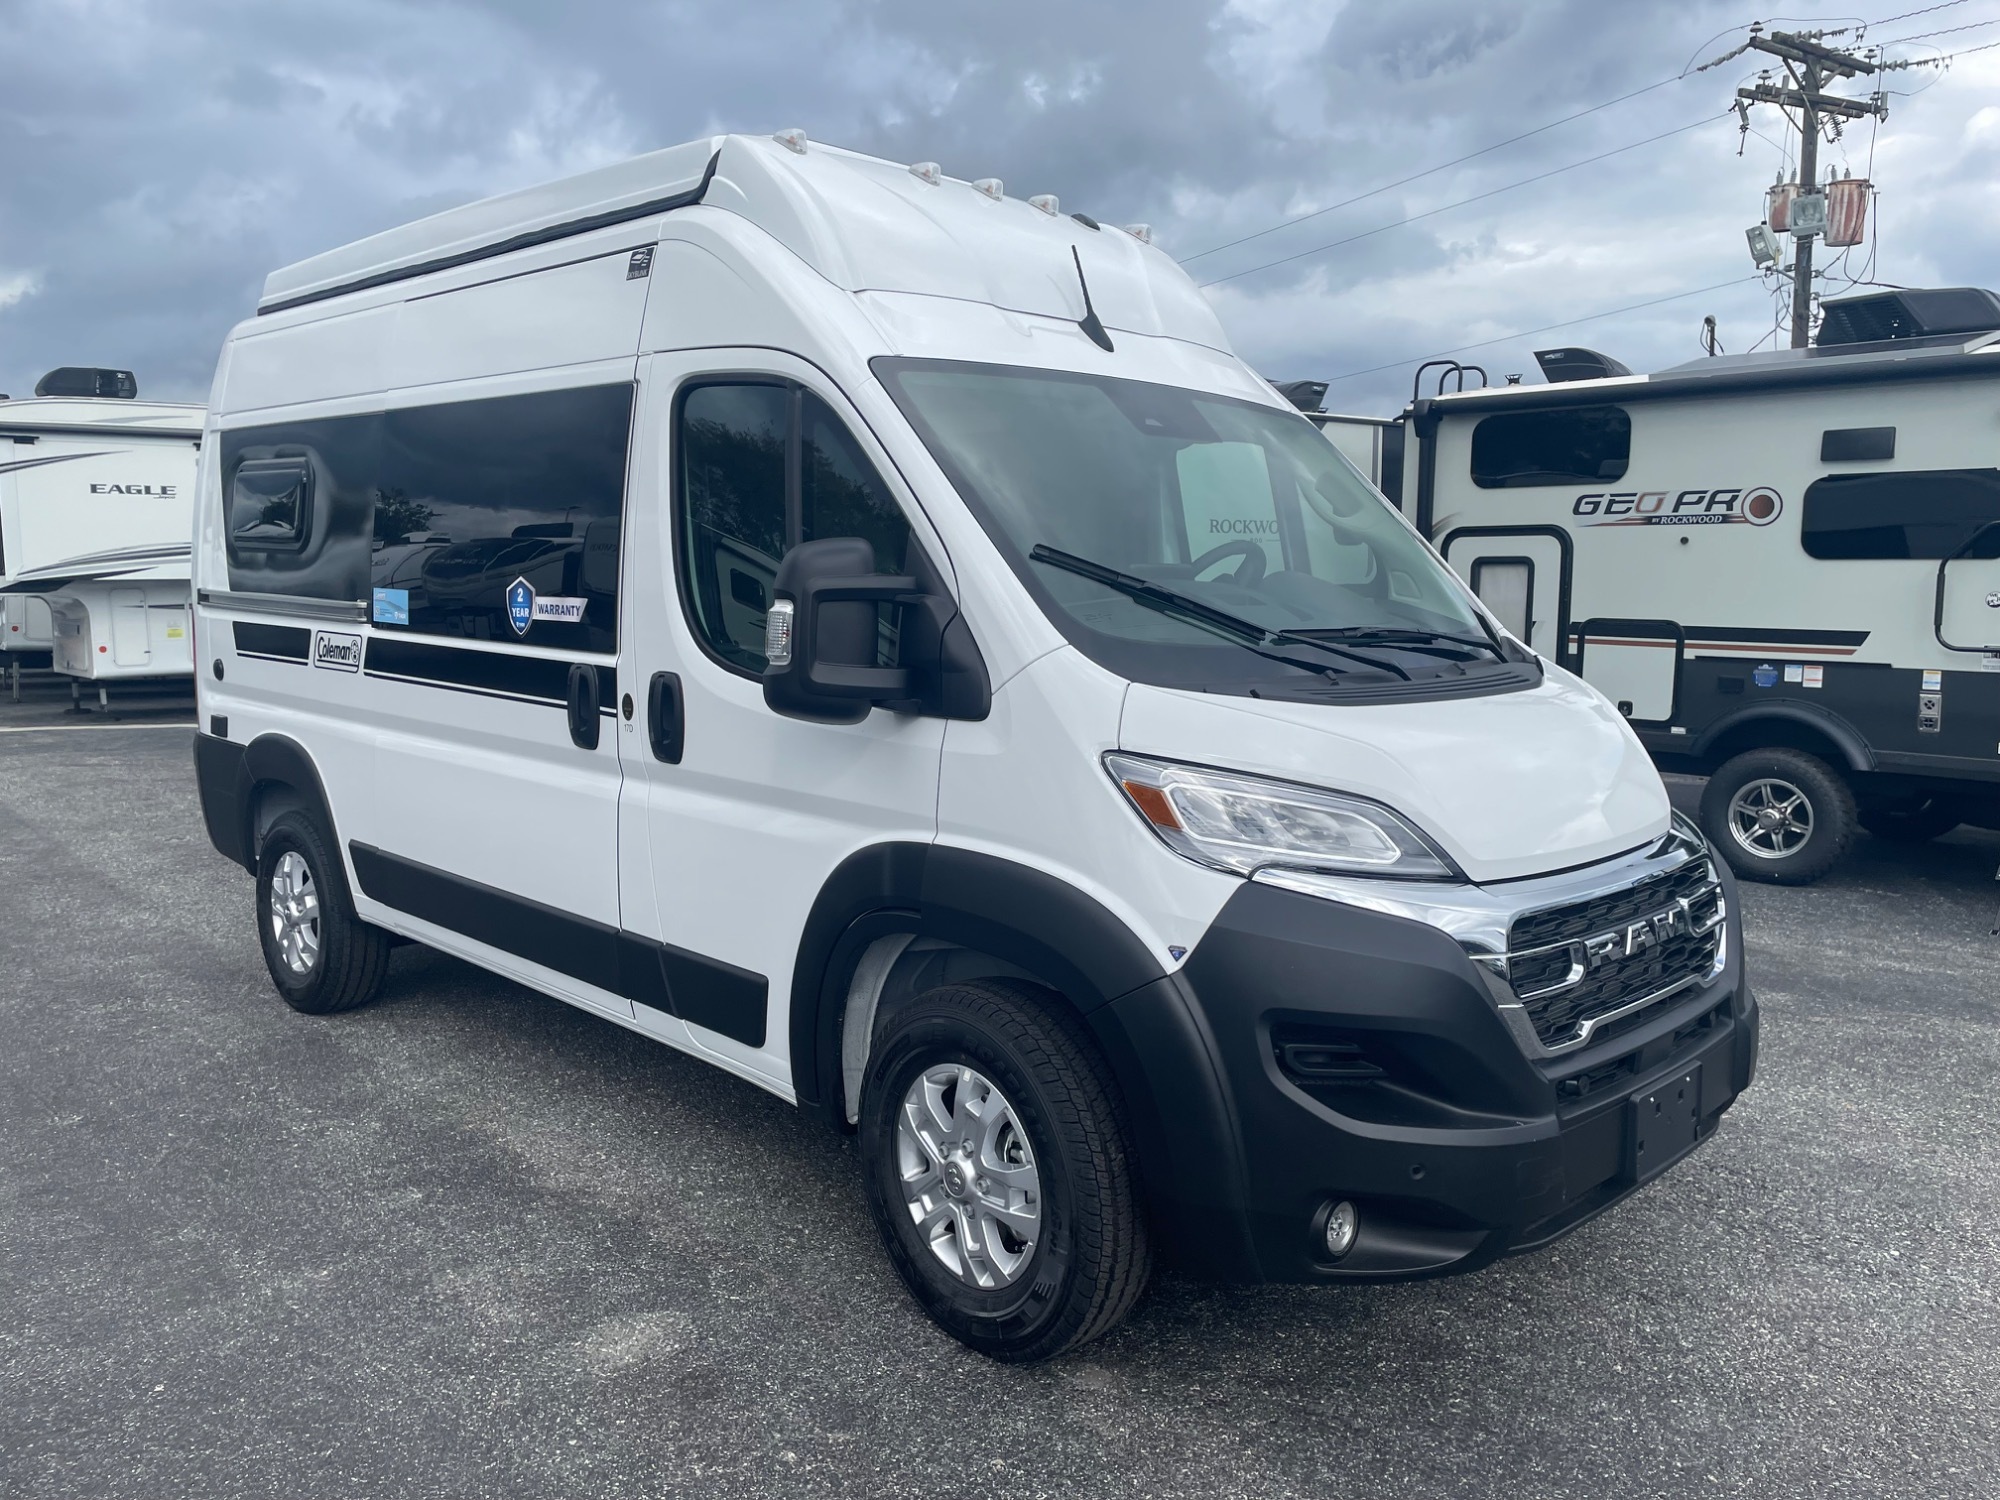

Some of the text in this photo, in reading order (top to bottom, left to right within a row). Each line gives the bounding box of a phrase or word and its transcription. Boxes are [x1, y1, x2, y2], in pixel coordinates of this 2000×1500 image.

[90, 484, 177, 495] EAGLE
[1572, 491, 1670, 516] GEO
[1660, 514, 1723, 525] ROCKWOOD
[517, 587, 524, 602] 2
[511, 607, 530, 618] YEAR
[537, 603, 581, 616] WARRANTY
[317, 636, 351, 661] Coleman
[1584, 906, 1685, 969] RAM
